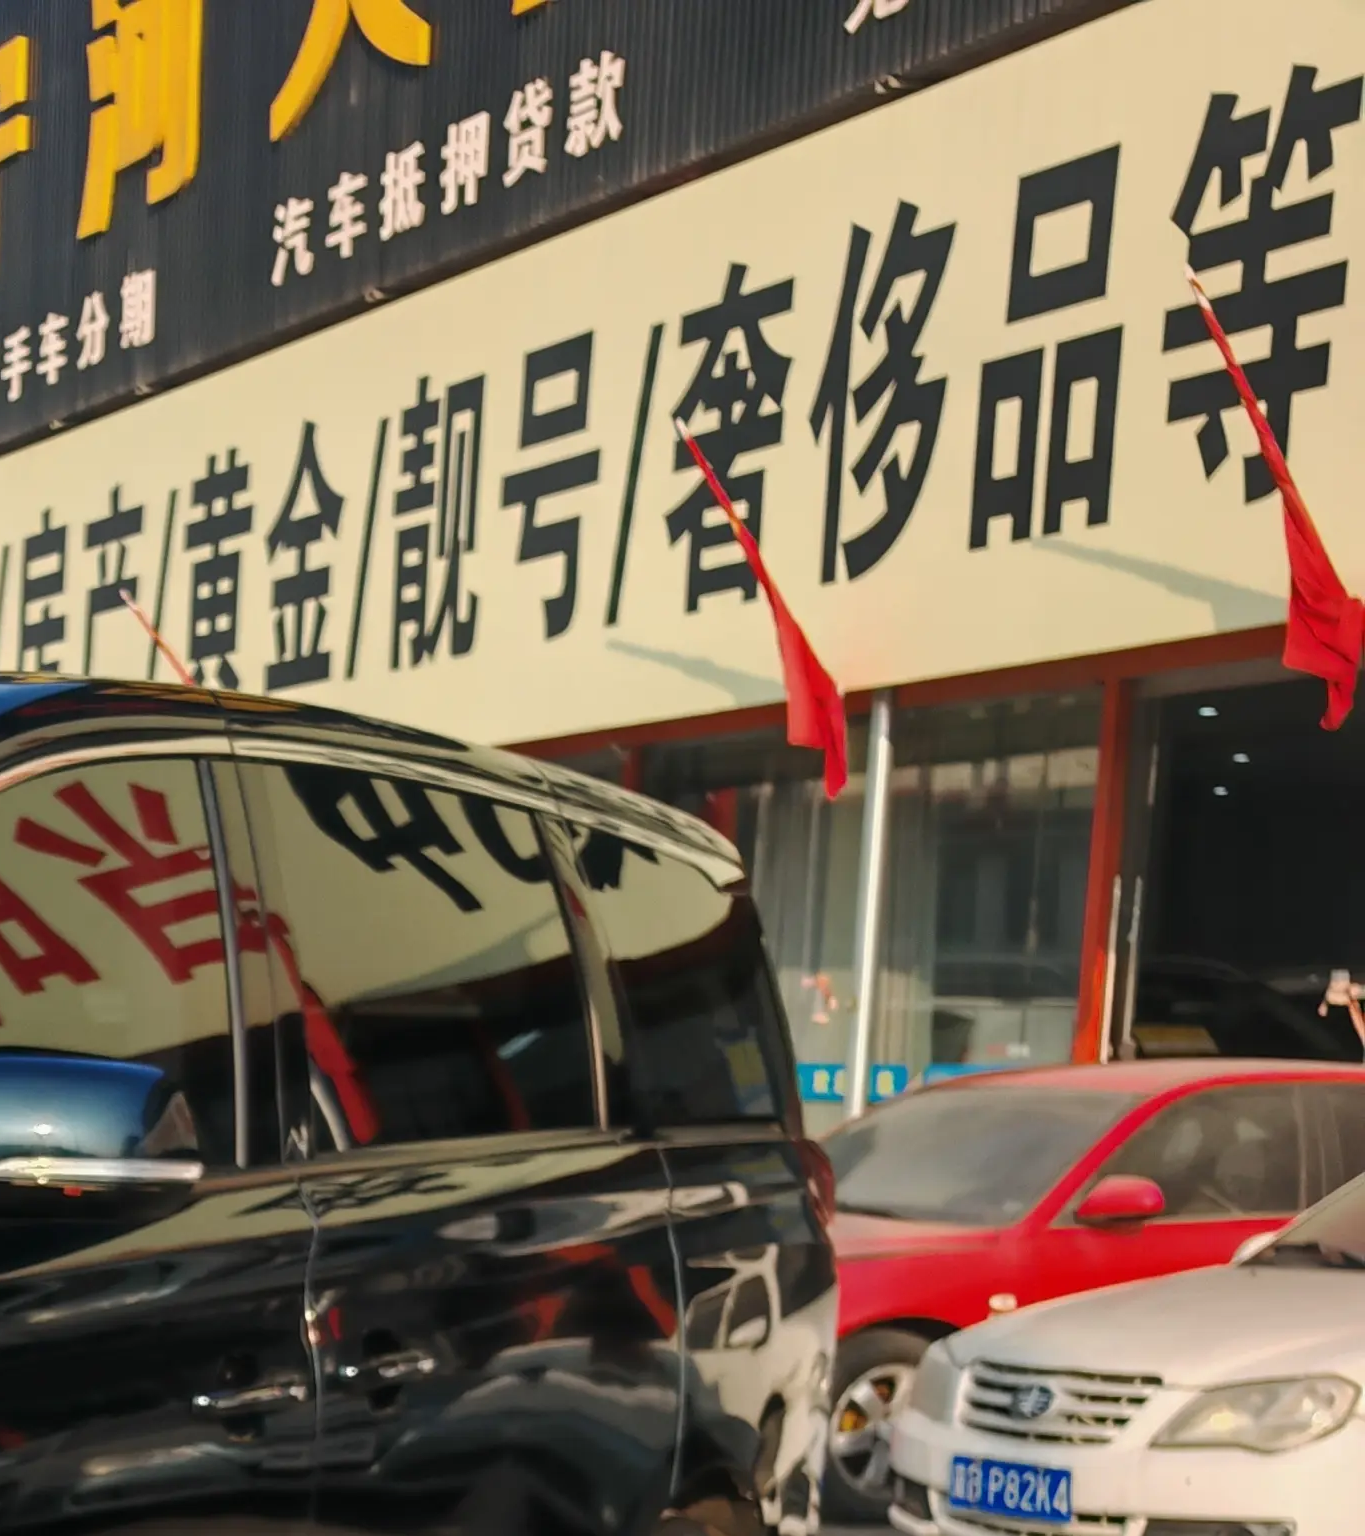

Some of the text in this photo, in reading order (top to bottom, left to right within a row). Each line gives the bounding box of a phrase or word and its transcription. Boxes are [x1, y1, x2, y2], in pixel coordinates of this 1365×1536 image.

[271, 50, 626, 286] 汽车抵押贷款
